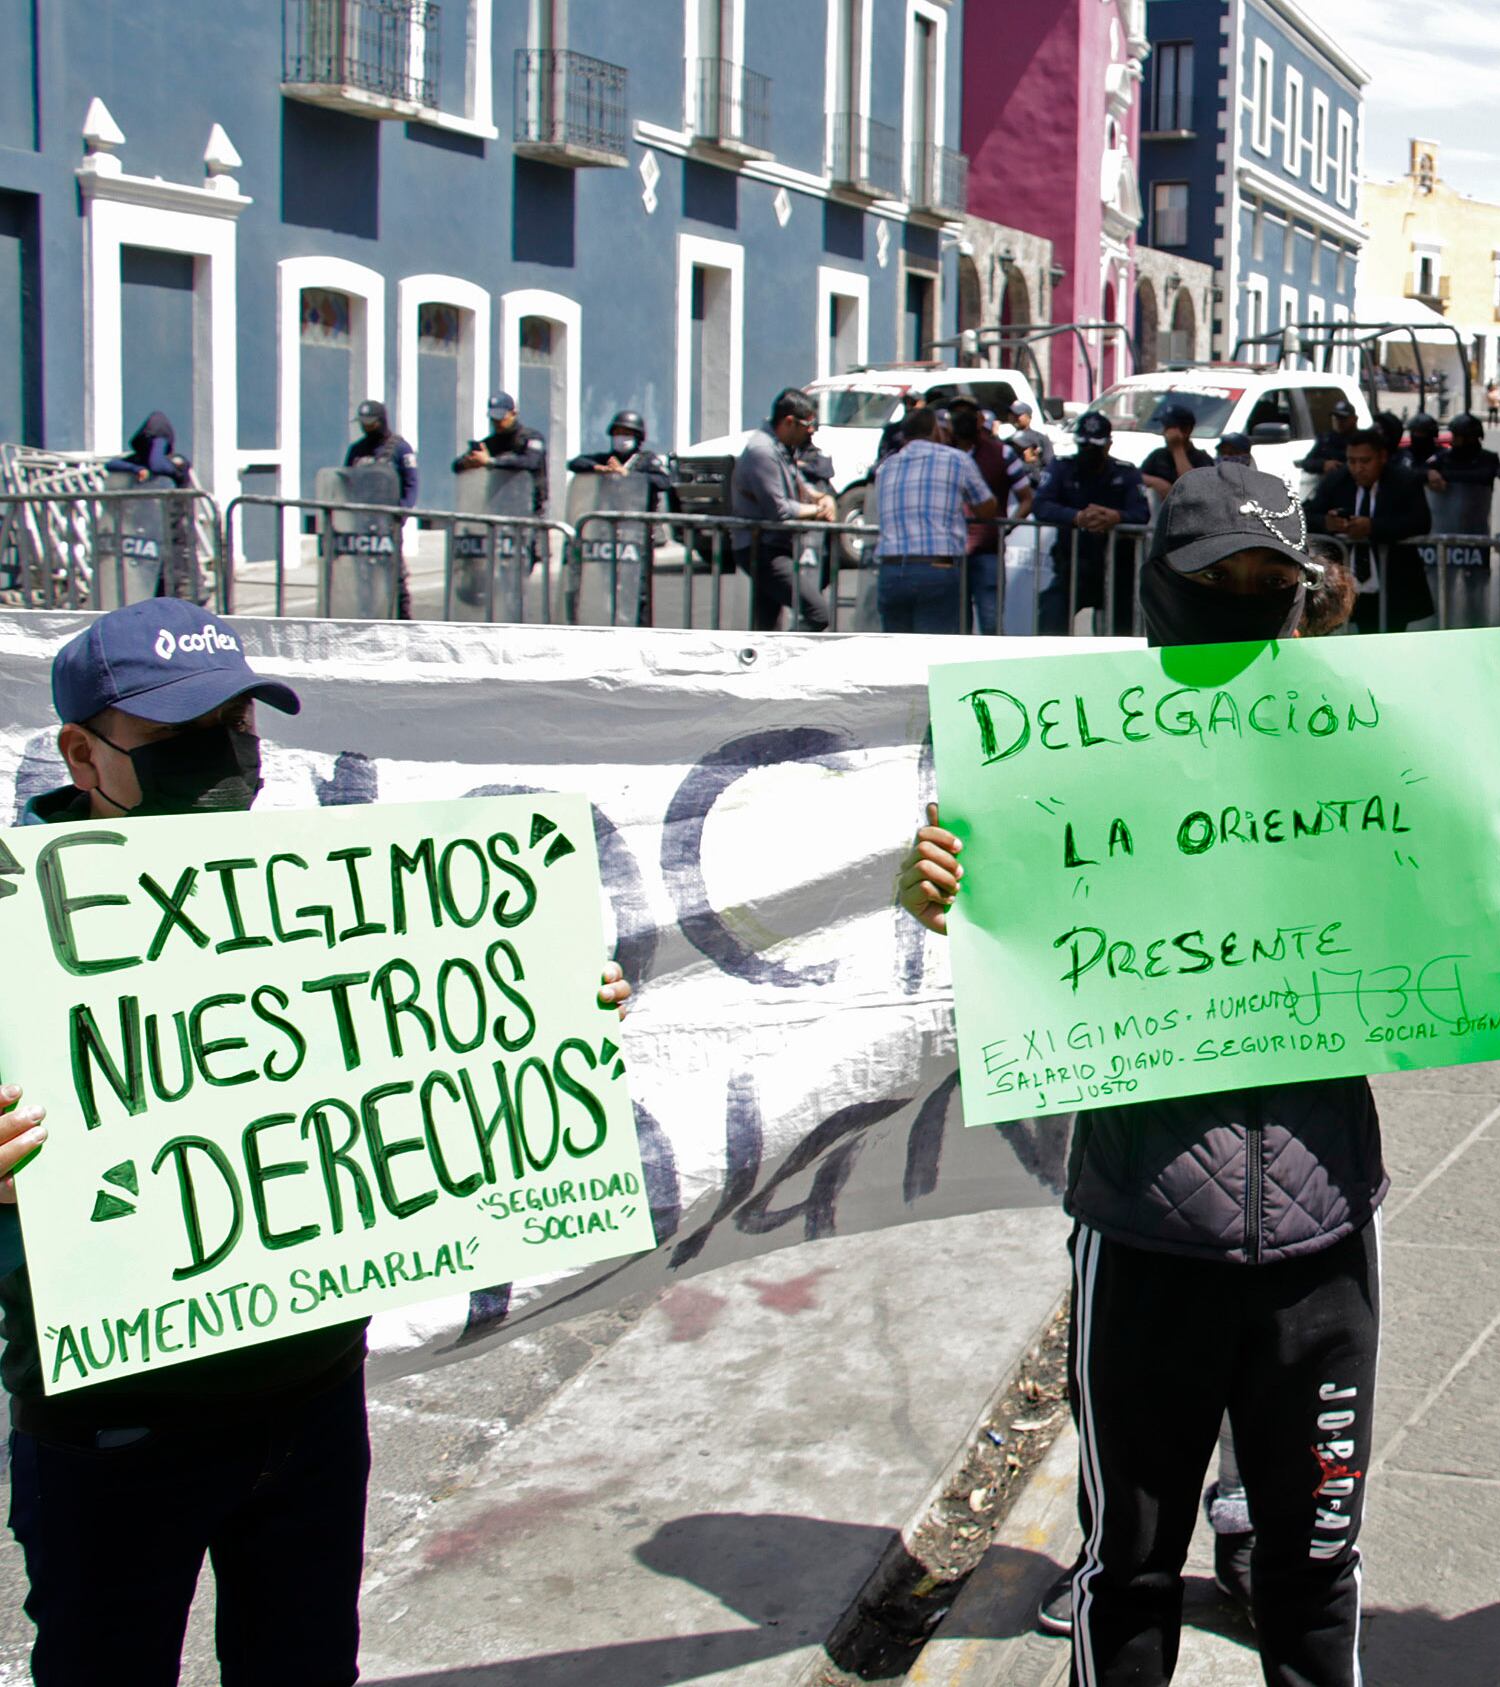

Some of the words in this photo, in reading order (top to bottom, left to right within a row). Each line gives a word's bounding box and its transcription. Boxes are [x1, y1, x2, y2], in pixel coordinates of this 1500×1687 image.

[1053, 921, 1352, 996] PRESENTE
[68, 939, 536, 1131] NUESTROS
[987, 1064, 1096, 1096] SALARIO
[1193, 1032, 1346, 1061] SEGURIDAD
[1365, 1022, 1438, 1043] SOCIAL
[1058, 1078, 1138, 1104] JUSTO
